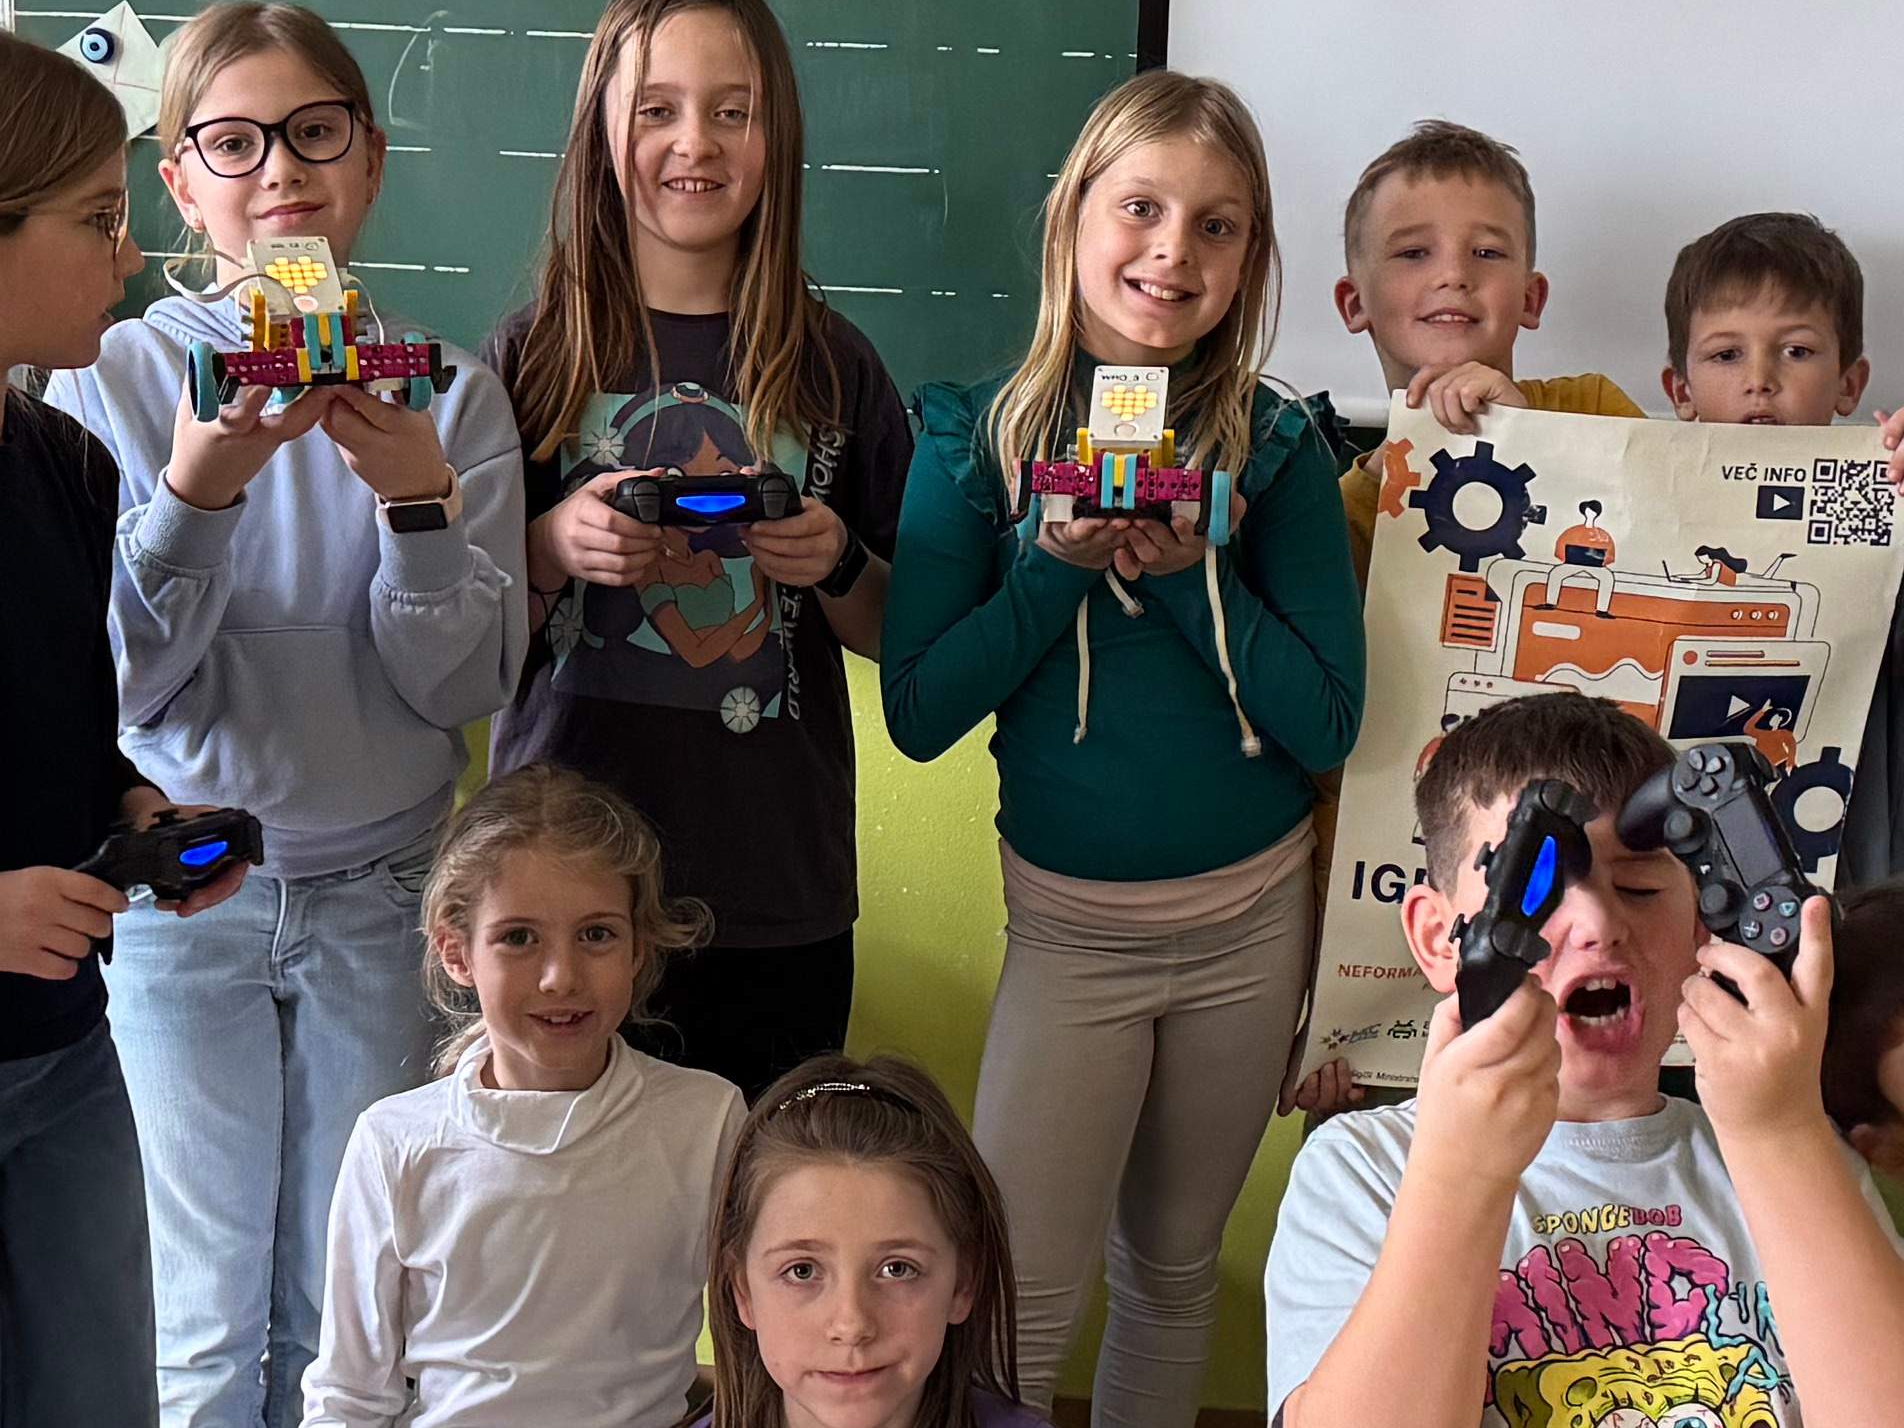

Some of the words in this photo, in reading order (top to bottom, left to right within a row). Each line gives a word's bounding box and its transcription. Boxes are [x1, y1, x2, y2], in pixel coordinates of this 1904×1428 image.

[1720, 463, 1757, 482] VEČ
[1763, 465, 1808, 484] INFO
[1533, 1203, 1683, 1235] SPONGEBOB
